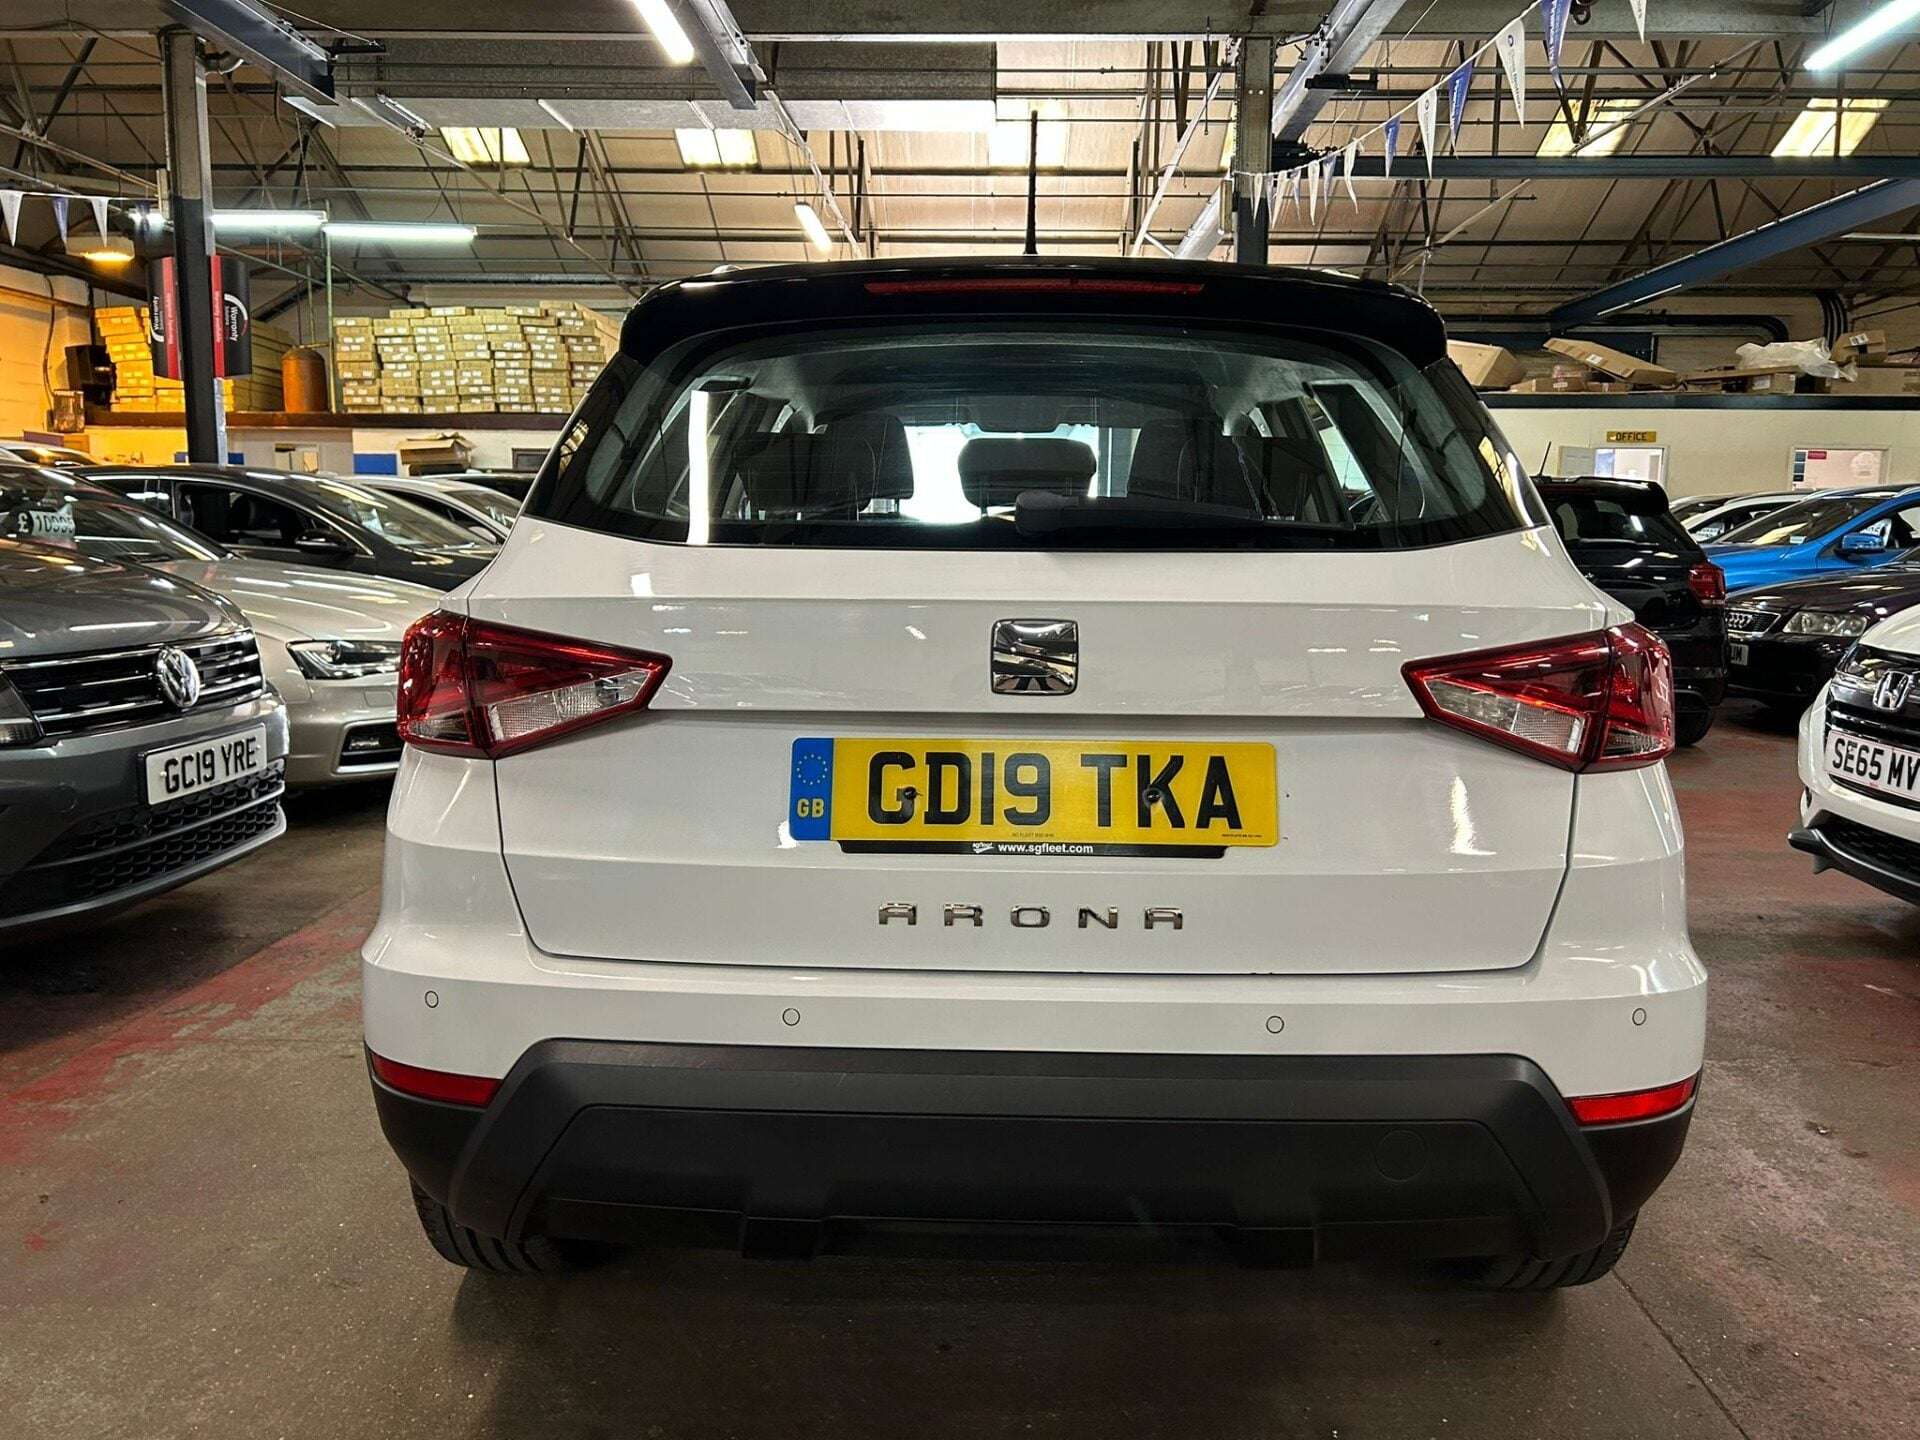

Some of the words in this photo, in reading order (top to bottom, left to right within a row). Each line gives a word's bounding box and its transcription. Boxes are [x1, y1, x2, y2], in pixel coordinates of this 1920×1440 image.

[230, 306, 239, 341] Warranty
[1616, 431, 1648, 441] OFFICE
[164, 748, 216, 794] GC19
[220, 736, 257, 777] YRE
[1832, 737, 1885, 781] SE65
[867, 751, 1052, 827] GD19
[1080, 753, 1243, 830] TKA
[797, 798, 825, 818] GB
[998, 843, 1094, 855] www.sgfleet.com
[878, 903, 1184, 930] ARONA
